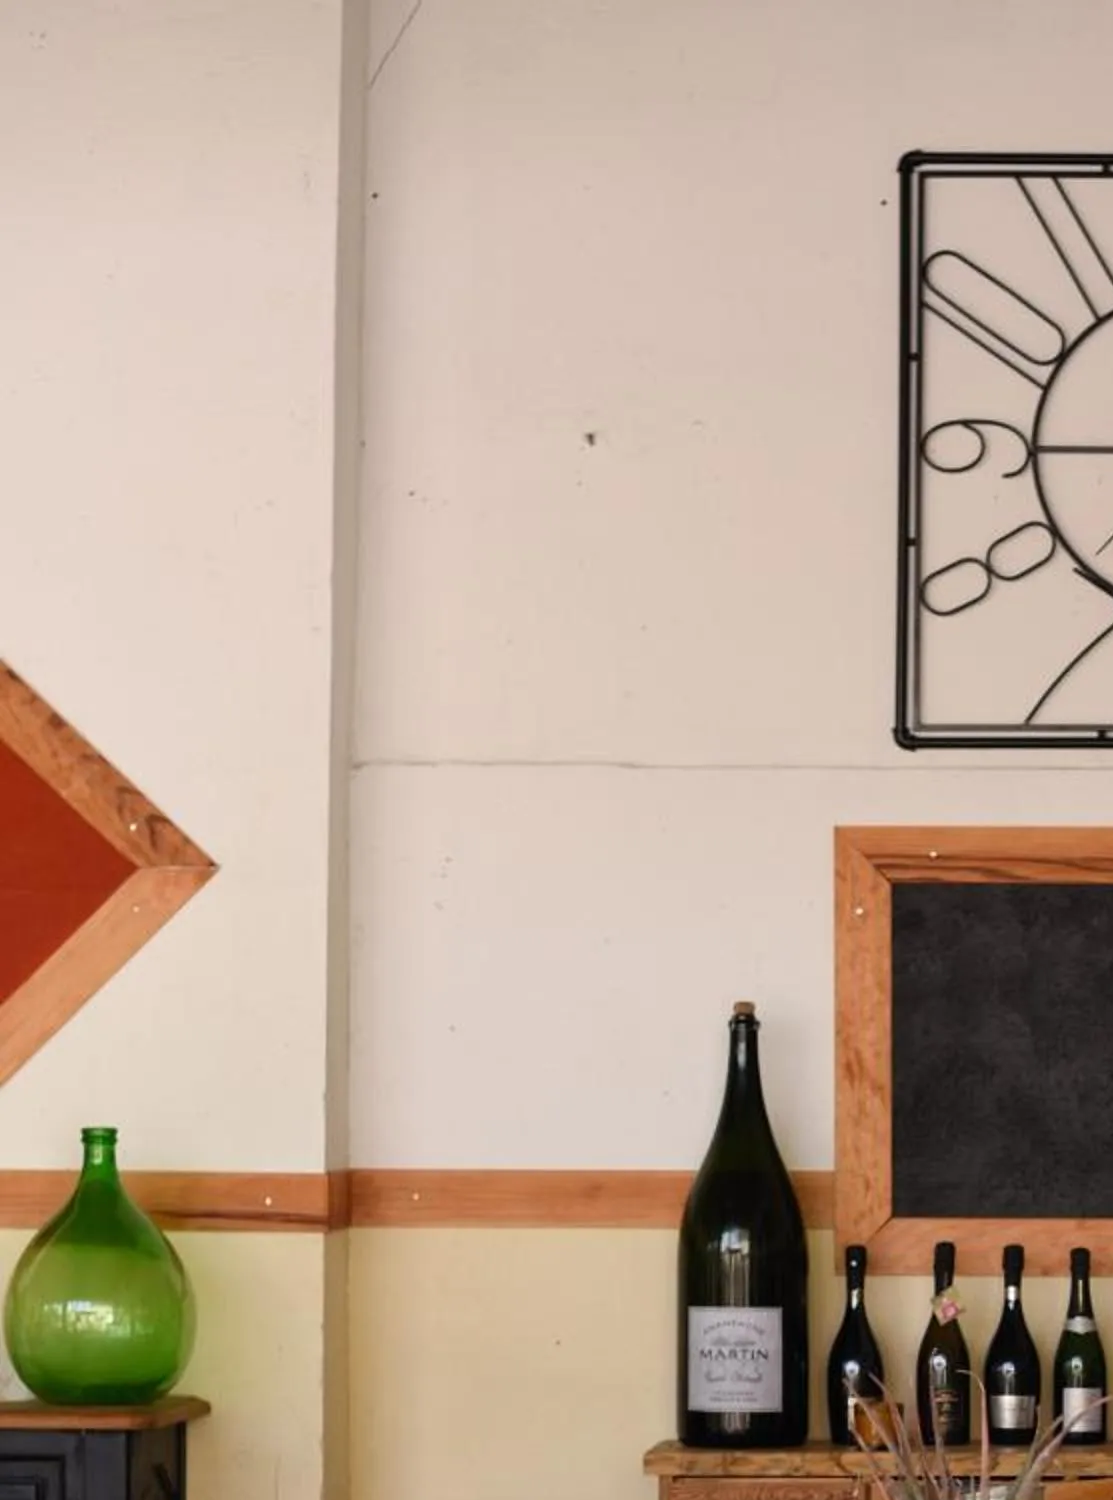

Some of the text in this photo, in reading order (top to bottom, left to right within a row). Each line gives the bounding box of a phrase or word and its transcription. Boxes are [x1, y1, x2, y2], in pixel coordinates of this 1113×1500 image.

[922, 250, 1067, 390] 10
[921, 419, 1033, 478] 9
[920, 521, 1057, 617] 8
[700, 1348, 768, 1361] MARTIN
